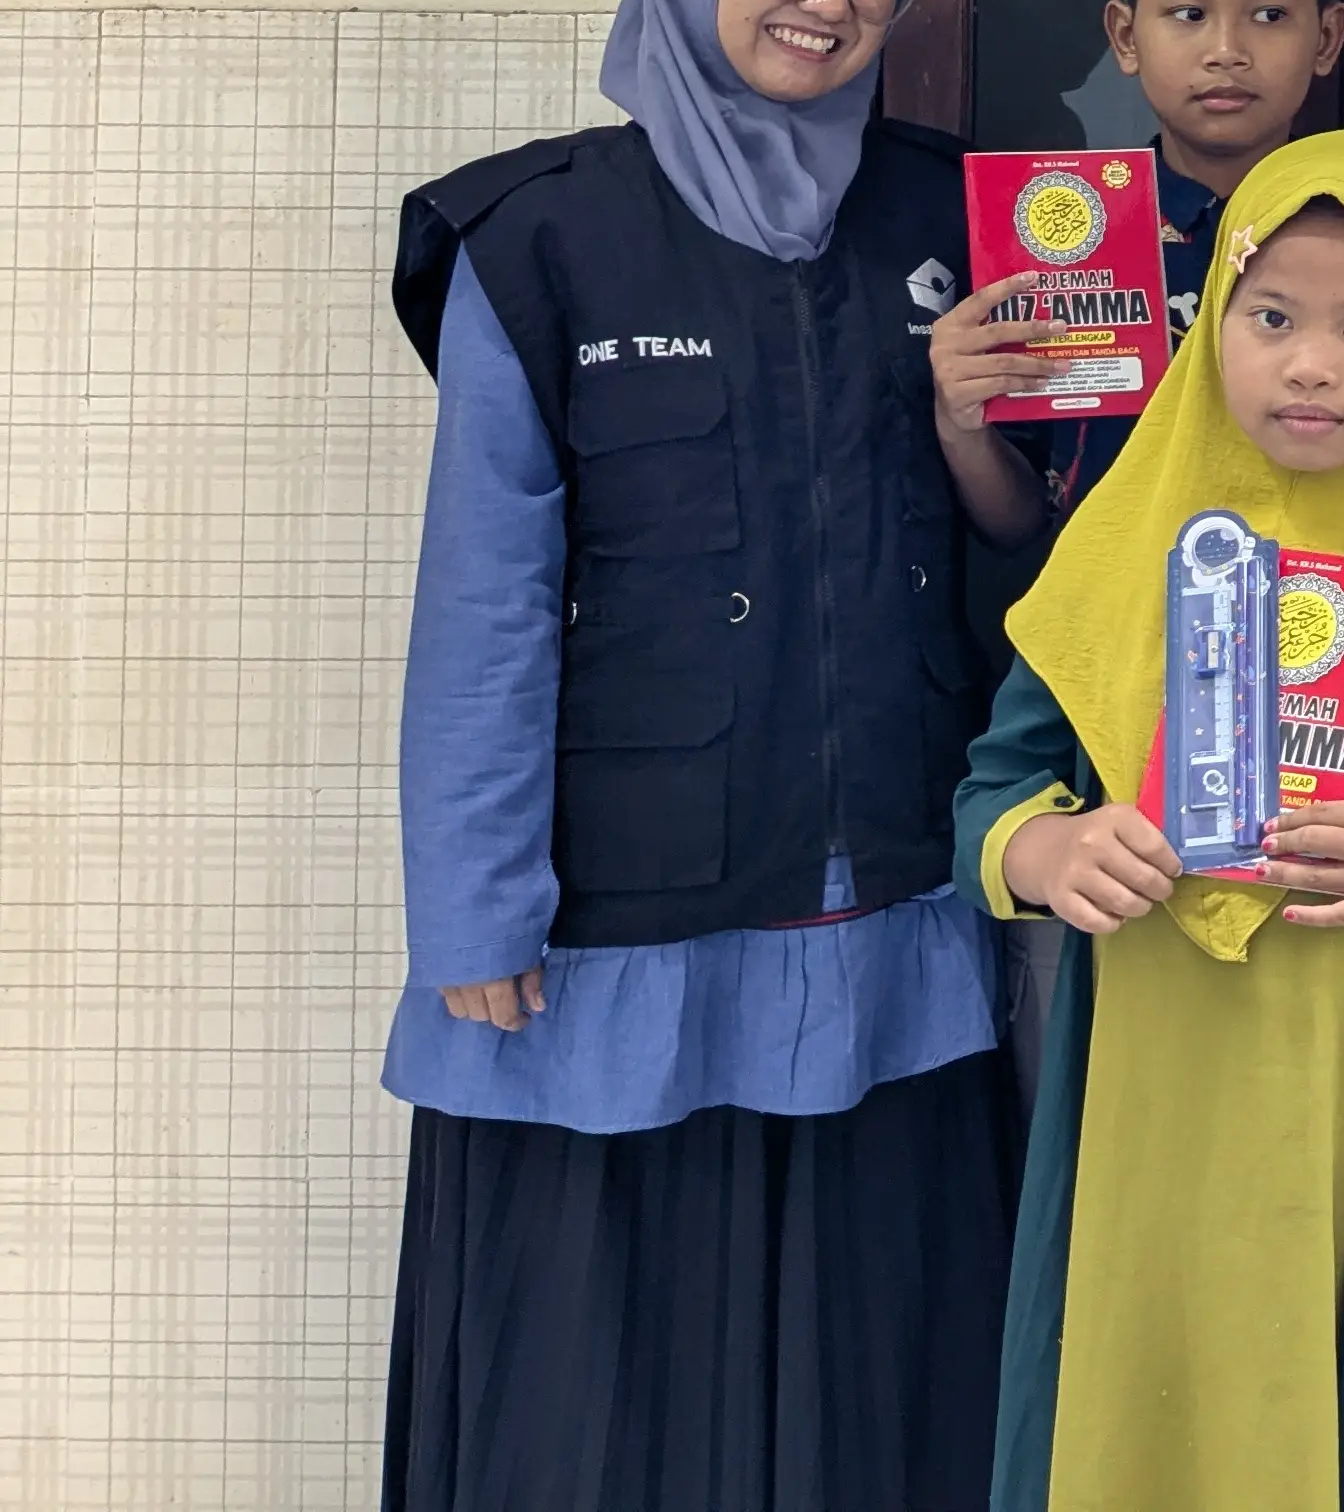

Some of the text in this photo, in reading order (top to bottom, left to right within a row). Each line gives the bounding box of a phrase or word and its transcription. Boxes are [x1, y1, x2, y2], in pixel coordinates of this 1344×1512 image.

[1030, 269, 1113, 290] RJEMAH
[1053, 333, 1112, 344] TERLENGKAP
[579, 337, 712, 366] ONE TEAM
[1118, 346, 1140, 355] BACA
[1281, 794, 1312, 807] TANDA
